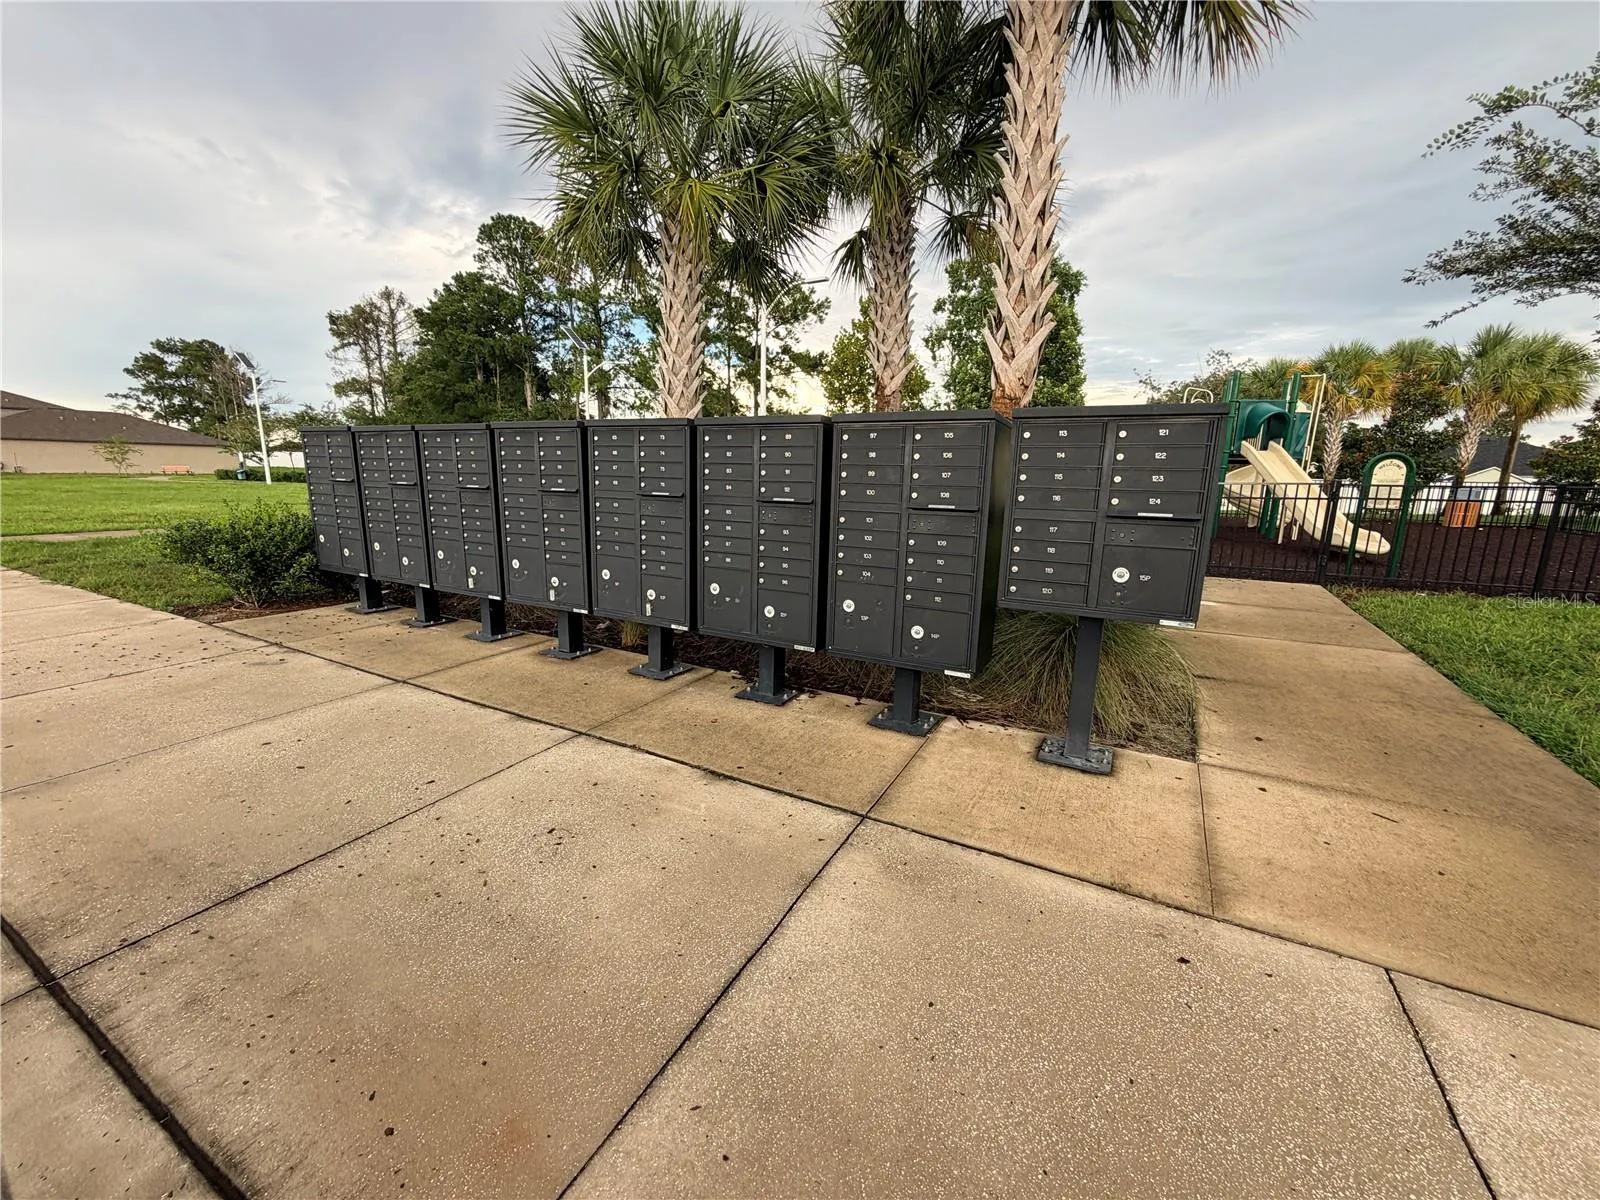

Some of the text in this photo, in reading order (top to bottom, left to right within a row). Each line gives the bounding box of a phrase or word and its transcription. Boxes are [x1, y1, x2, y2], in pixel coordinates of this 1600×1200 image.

[1158, 428, 1169, 437] 121
[1154, 452, 1167, 460] 122
[1054, 473, 1064, 481] 115
[1149, 497, 1161, 505] 124
[1139, 574, 1152, 582] 15P
